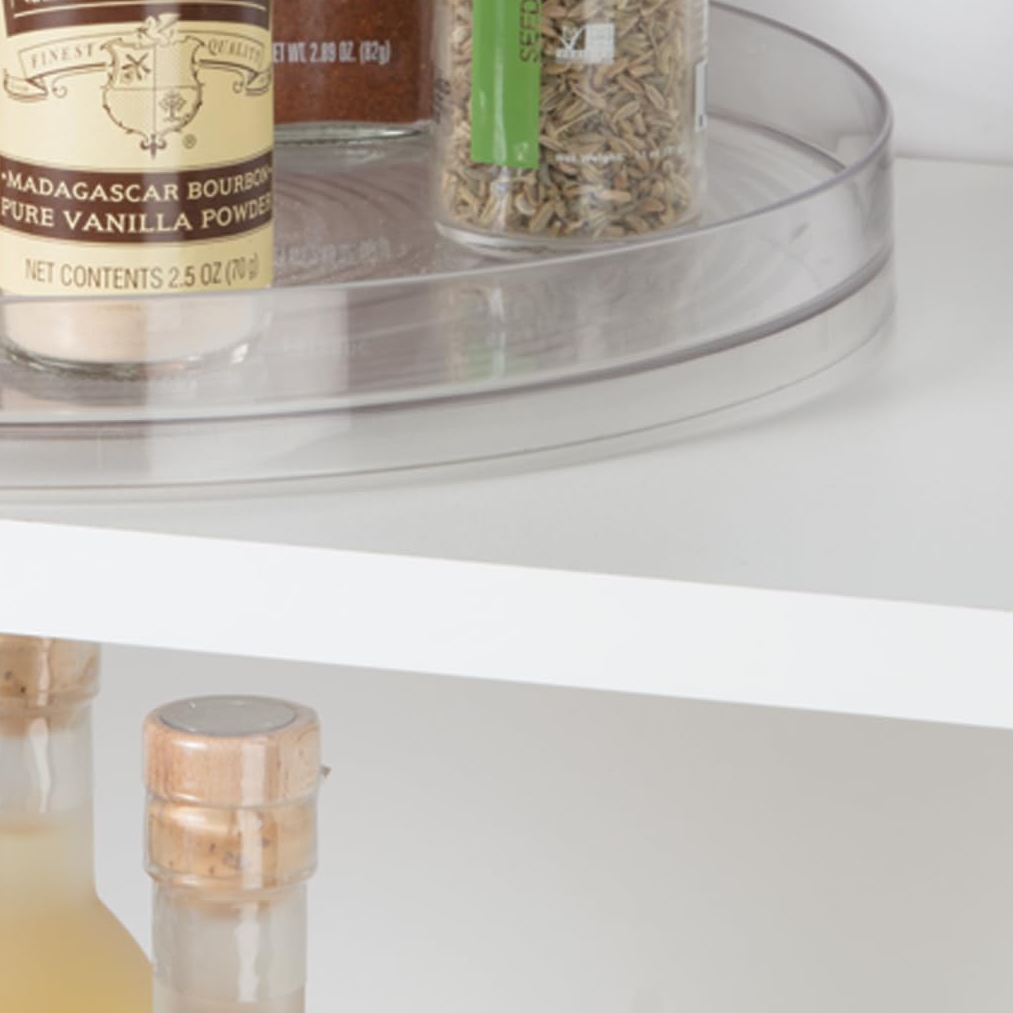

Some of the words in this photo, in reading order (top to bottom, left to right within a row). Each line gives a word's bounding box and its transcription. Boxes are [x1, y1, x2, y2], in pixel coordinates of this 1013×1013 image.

[30, 44, 95, 70] FINEST
[0, 196, 55, 228] PURE
[63, 209, 194, 234] VANILLA
[25, 257, 55, 284] NET
[60, 262, 164, 290] CONTENTS
[167, 265, 195, 289] 2.5
[199, 260, 222, 286] OZ
